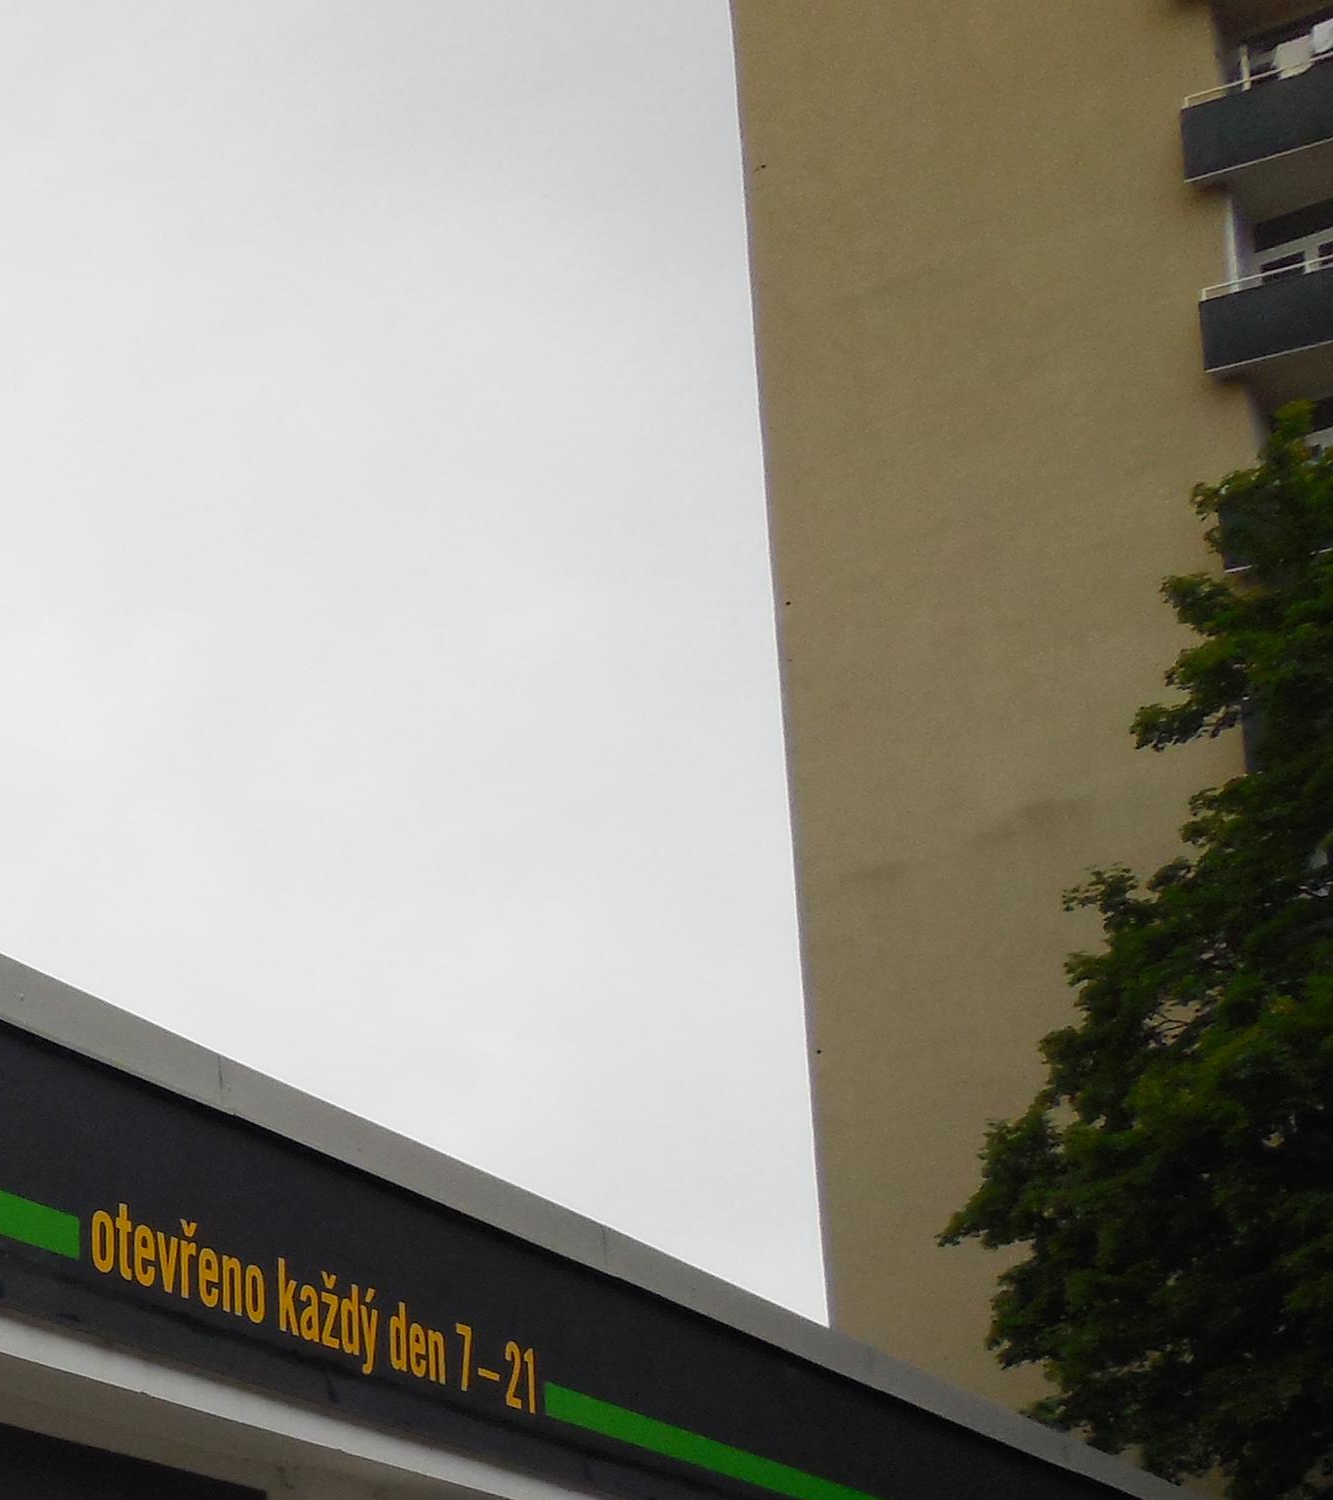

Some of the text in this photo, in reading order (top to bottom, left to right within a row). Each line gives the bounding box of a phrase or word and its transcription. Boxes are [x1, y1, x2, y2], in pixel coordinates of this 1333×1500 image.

[91, 1203, 266, 1324] otevřeno
[278, 1258, 378, 1374] každý
[389, 1302, 446, 1385] den
